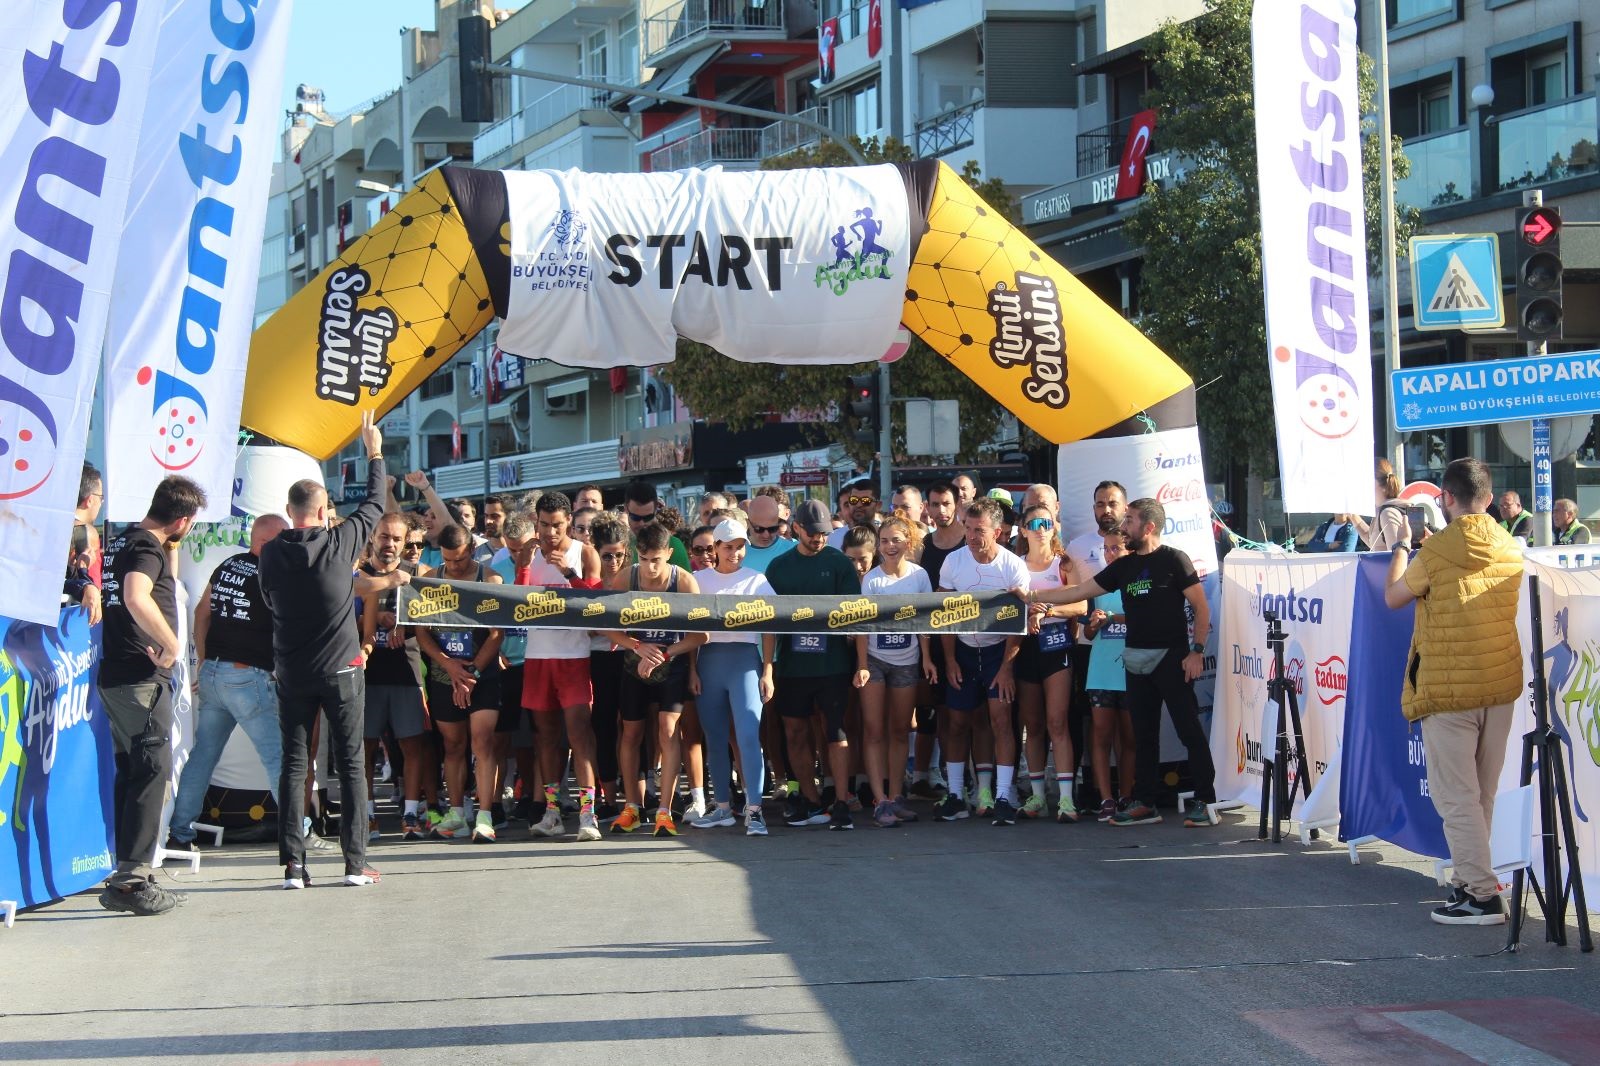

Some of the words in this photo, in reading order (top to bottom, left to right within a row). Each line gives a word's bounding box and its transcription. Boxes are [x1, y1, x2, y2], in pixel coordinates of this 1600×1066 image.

[604, 230, 793, 291] START
[1402, 370, 1486, 396] KAPALI
[1492, 359, 1600, 387] OTOPARK
[1426, 404, 1457, 415] AYDIN
[1460, 393, 1545, 412] BÜYÜKŞEHİR
[1536, 459, 1550, 470] 40
[1537, 473, 1550, 484] 09
[220, 570, 246, 587] TEAM
[410, 594, 458, 617] Sensin!
[516, 599, 563, 620] Sensin!
[621, 605, 668, 624] Sensin!
[830, 604, 877, 626] Sensin!
[931, 602, 979, 626] Sensin!
[726, 606, 773, 626] Sensin!
[1107, 623, 1128, 633] 428
[446, 642, 464, 652] 450
[800, 636, 820, 647] 362
[885, 634, 906, 644] 386
[1046, 633, 1067, 645] 353
